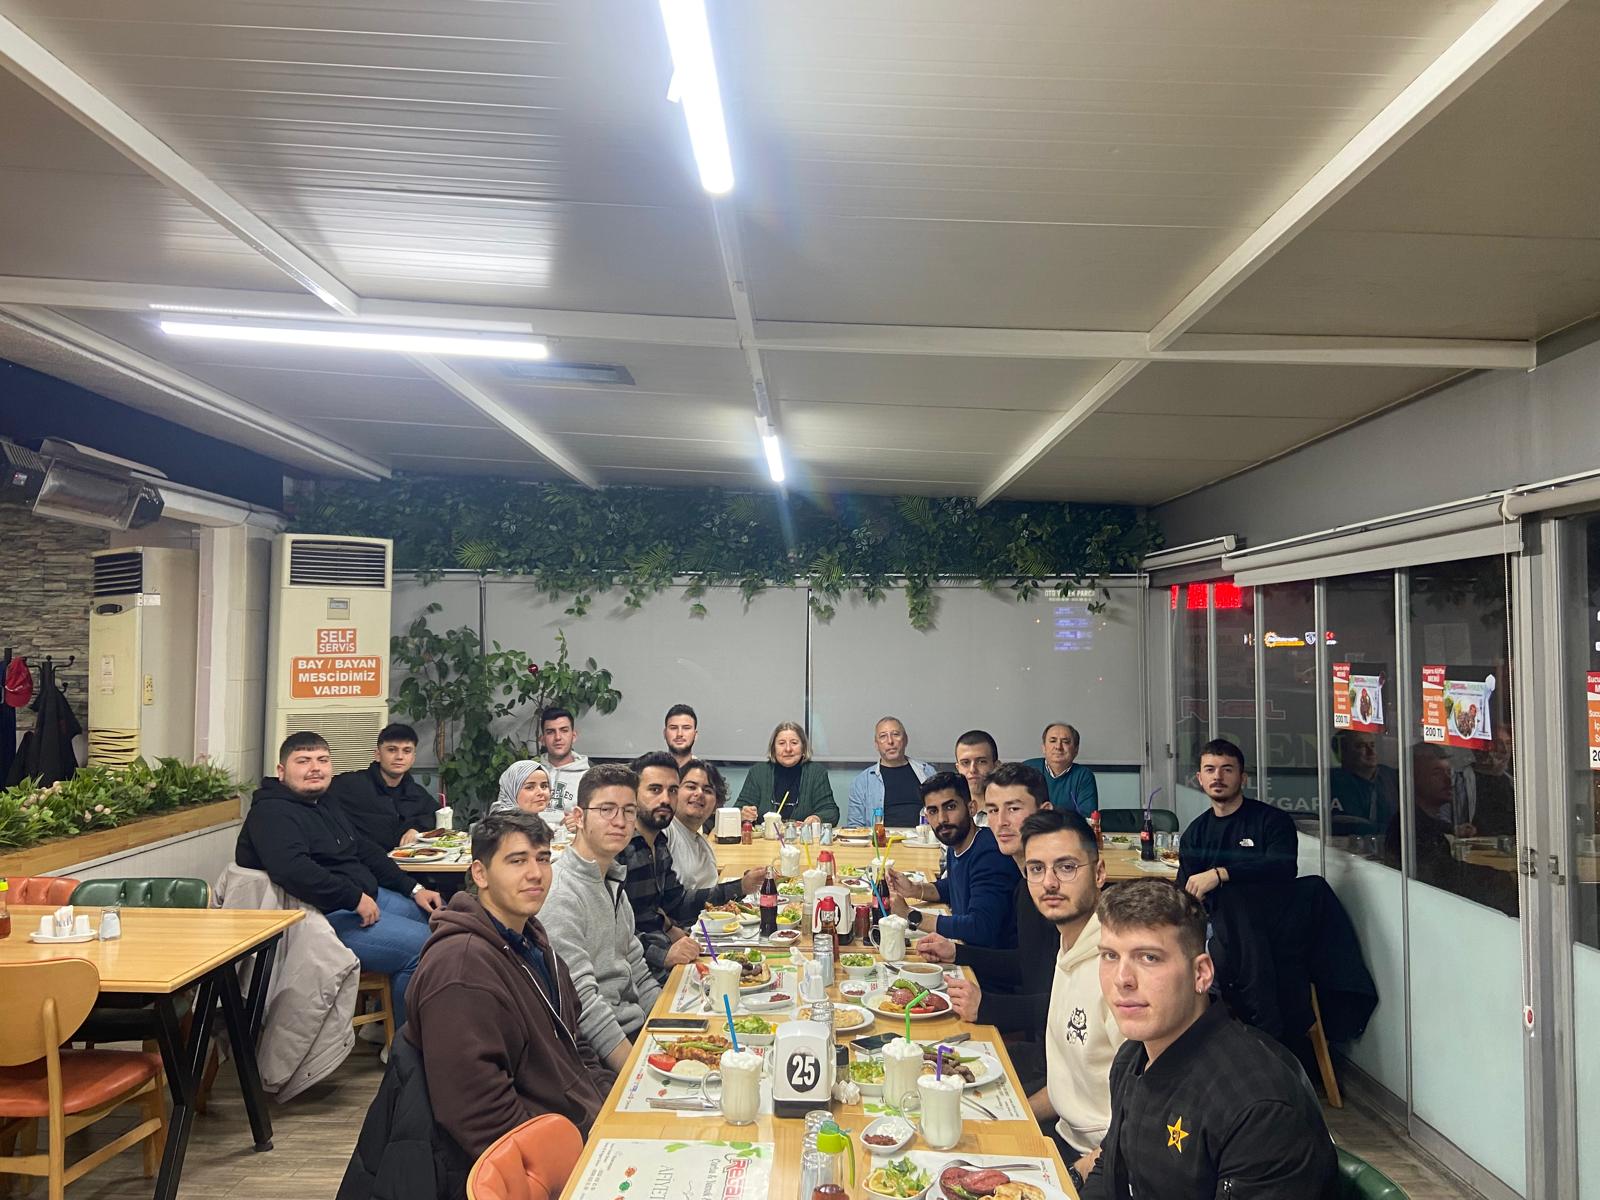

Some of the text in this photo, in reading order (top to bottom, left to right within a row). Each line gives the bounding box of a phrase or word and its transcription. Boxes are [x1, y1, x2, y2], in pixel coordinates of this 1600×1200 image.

[320, 631, 354, 643] SELF
[298, 659, 324, 669] BAY
[335, 659, 376, 669] BAYAN
[298, 671, 375, 682] MESCİDİMİZ
[313, 686, 361, 695] VARDIR
[1425, 726, 1443, 738] 200 TL
[791, 1054, 816, 1086] 25
